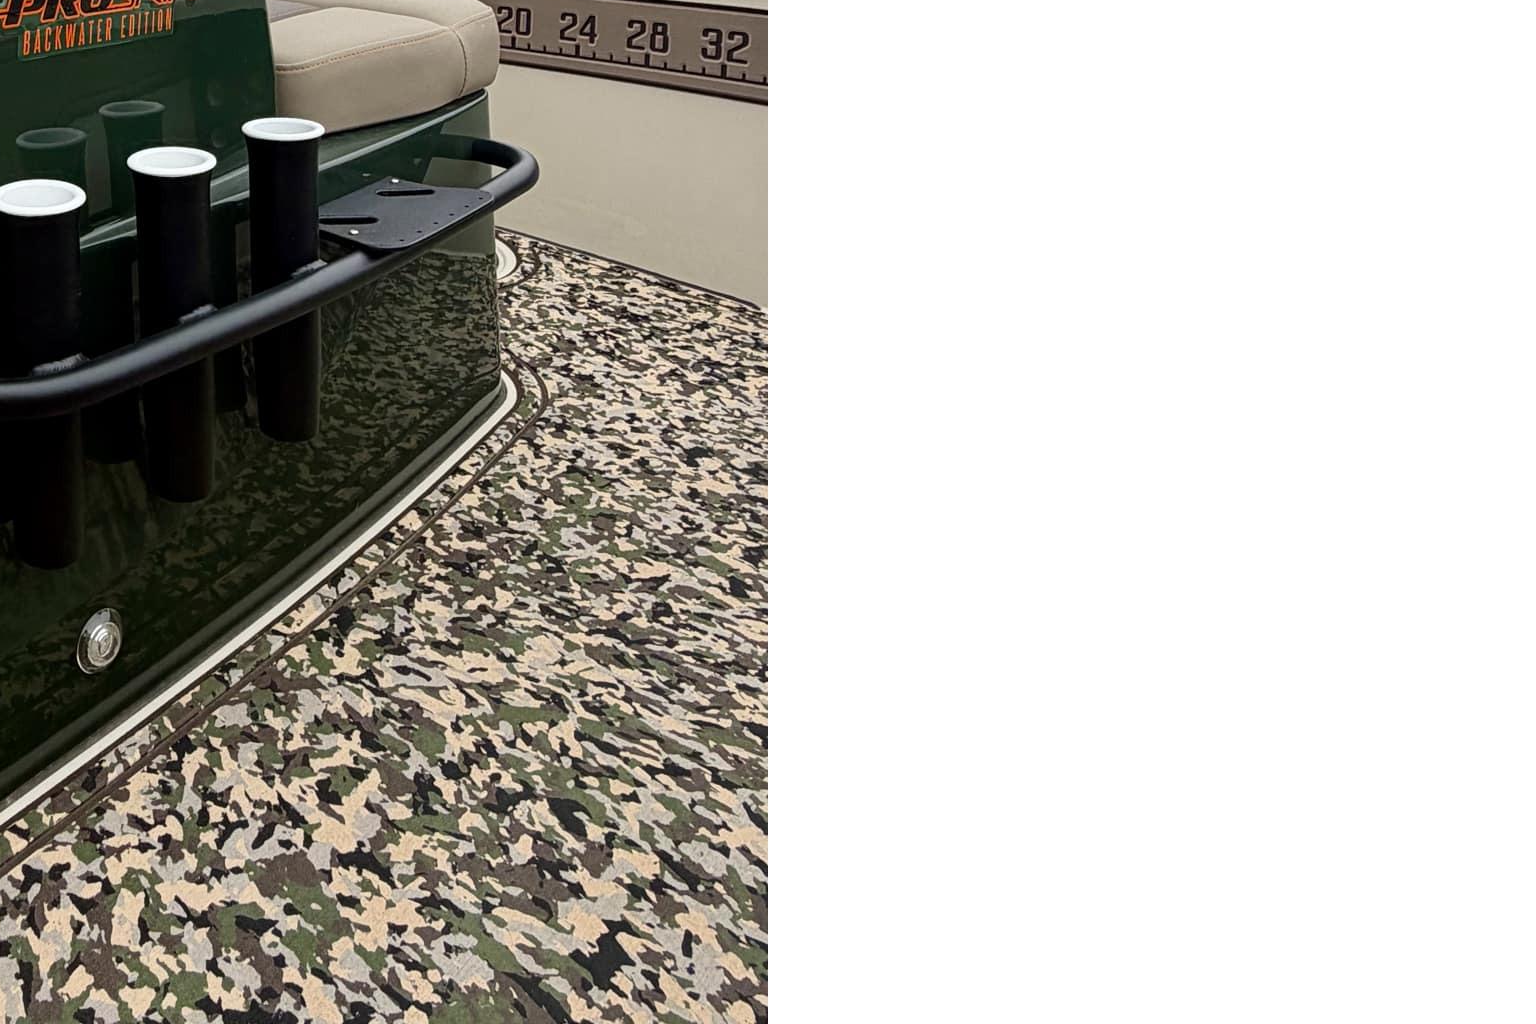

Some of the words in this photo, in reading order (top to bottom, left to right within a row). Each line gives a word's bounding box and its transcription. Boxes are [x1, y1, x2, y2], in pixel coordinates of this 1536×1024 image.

[22, 18, 113, 56] BACKWATER
[120, 7, 174, 39] EDITION
[496, 6, 532, 37] 20
[559, 12, 599, 44] 24
[626, 19, 670, 54] 28
[701, 27, 750, 65] 32
